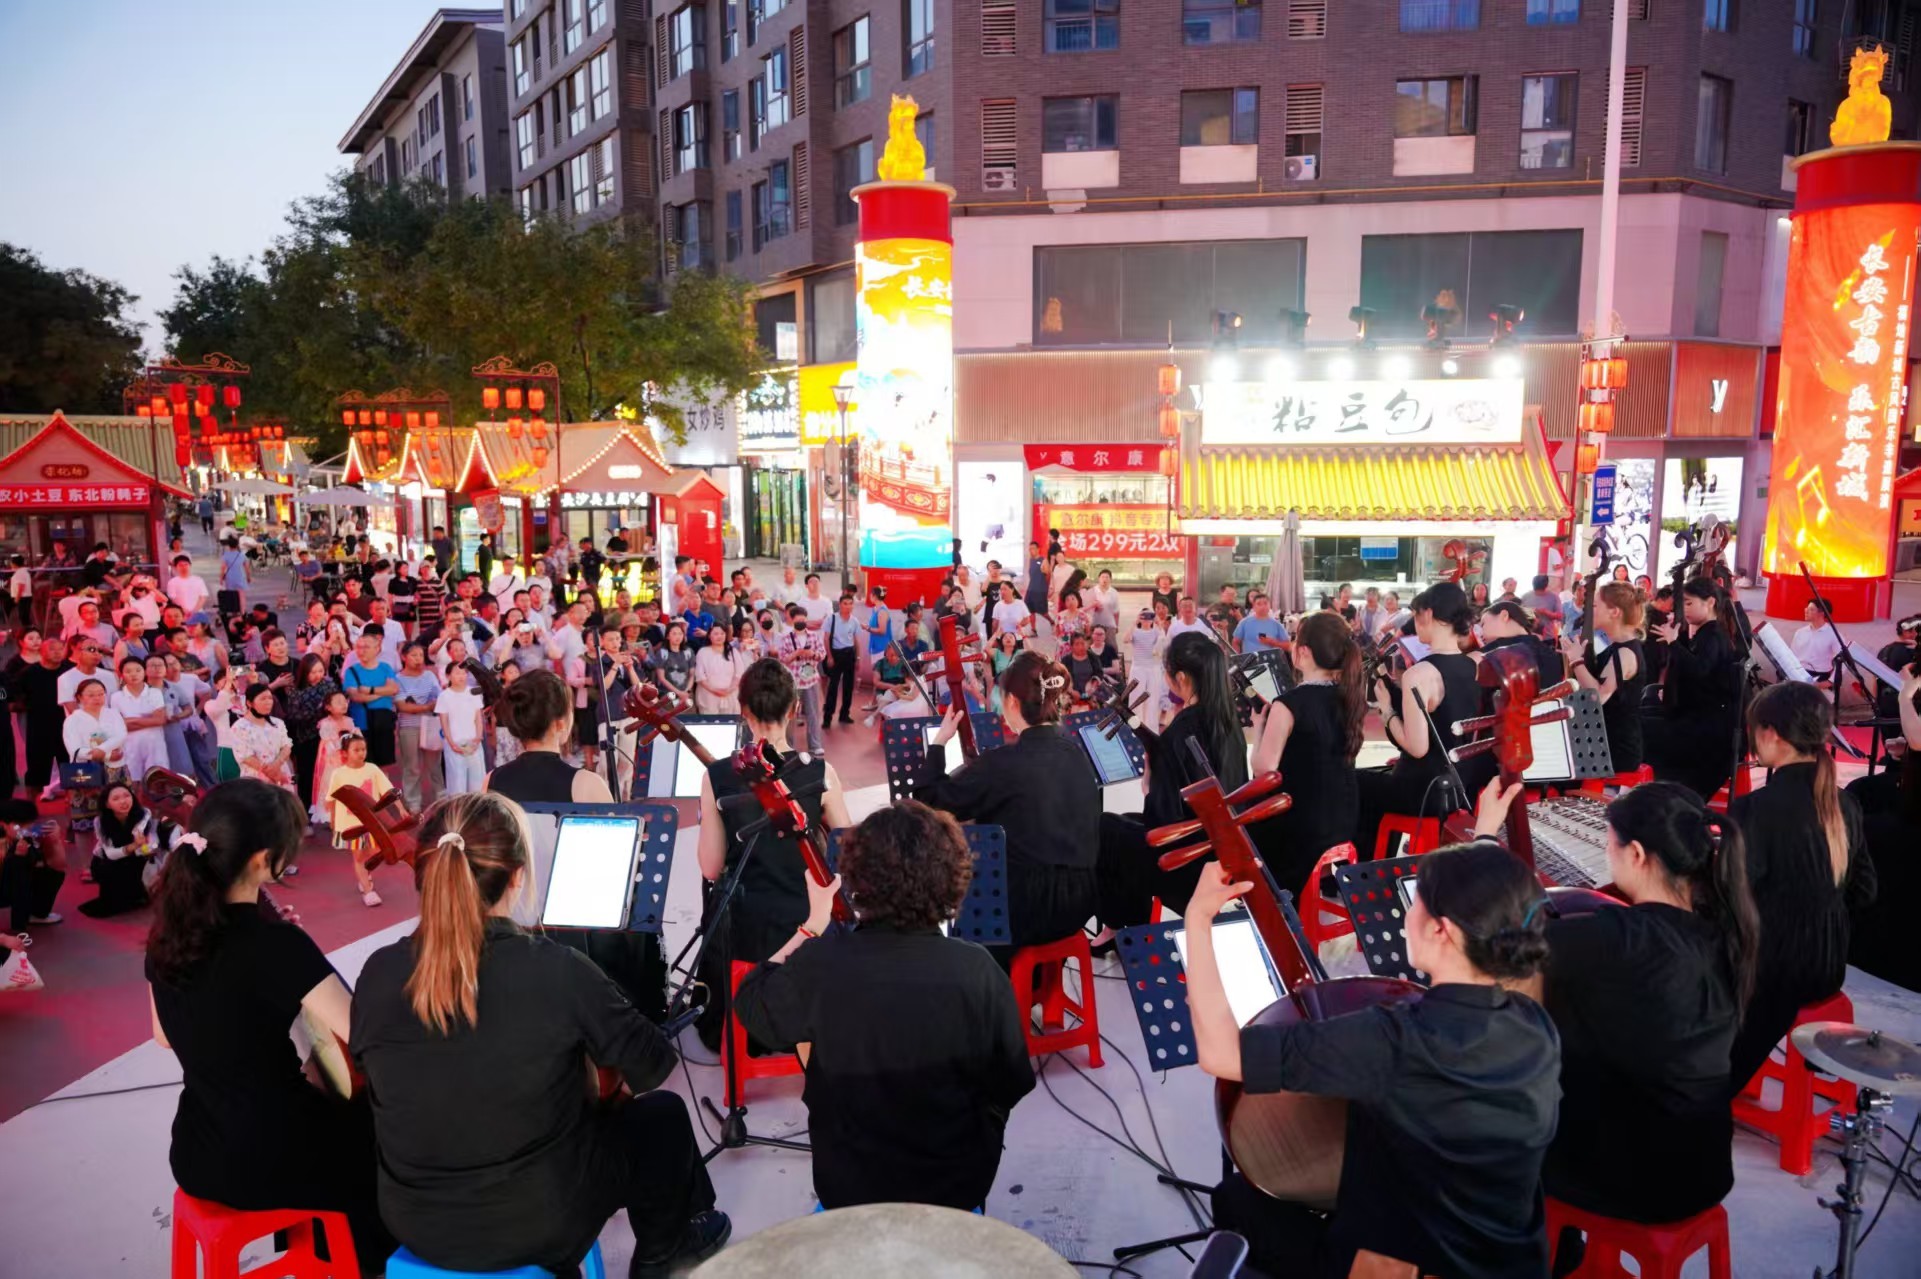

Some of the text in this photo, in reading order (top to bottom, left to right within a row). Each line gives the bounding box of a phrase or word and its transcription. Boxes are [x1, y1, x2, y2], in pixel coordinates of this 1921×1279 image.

[1273, 389, 1433, 435] 粘豆包
[1059, 450, 1144, 466] 意尔康
